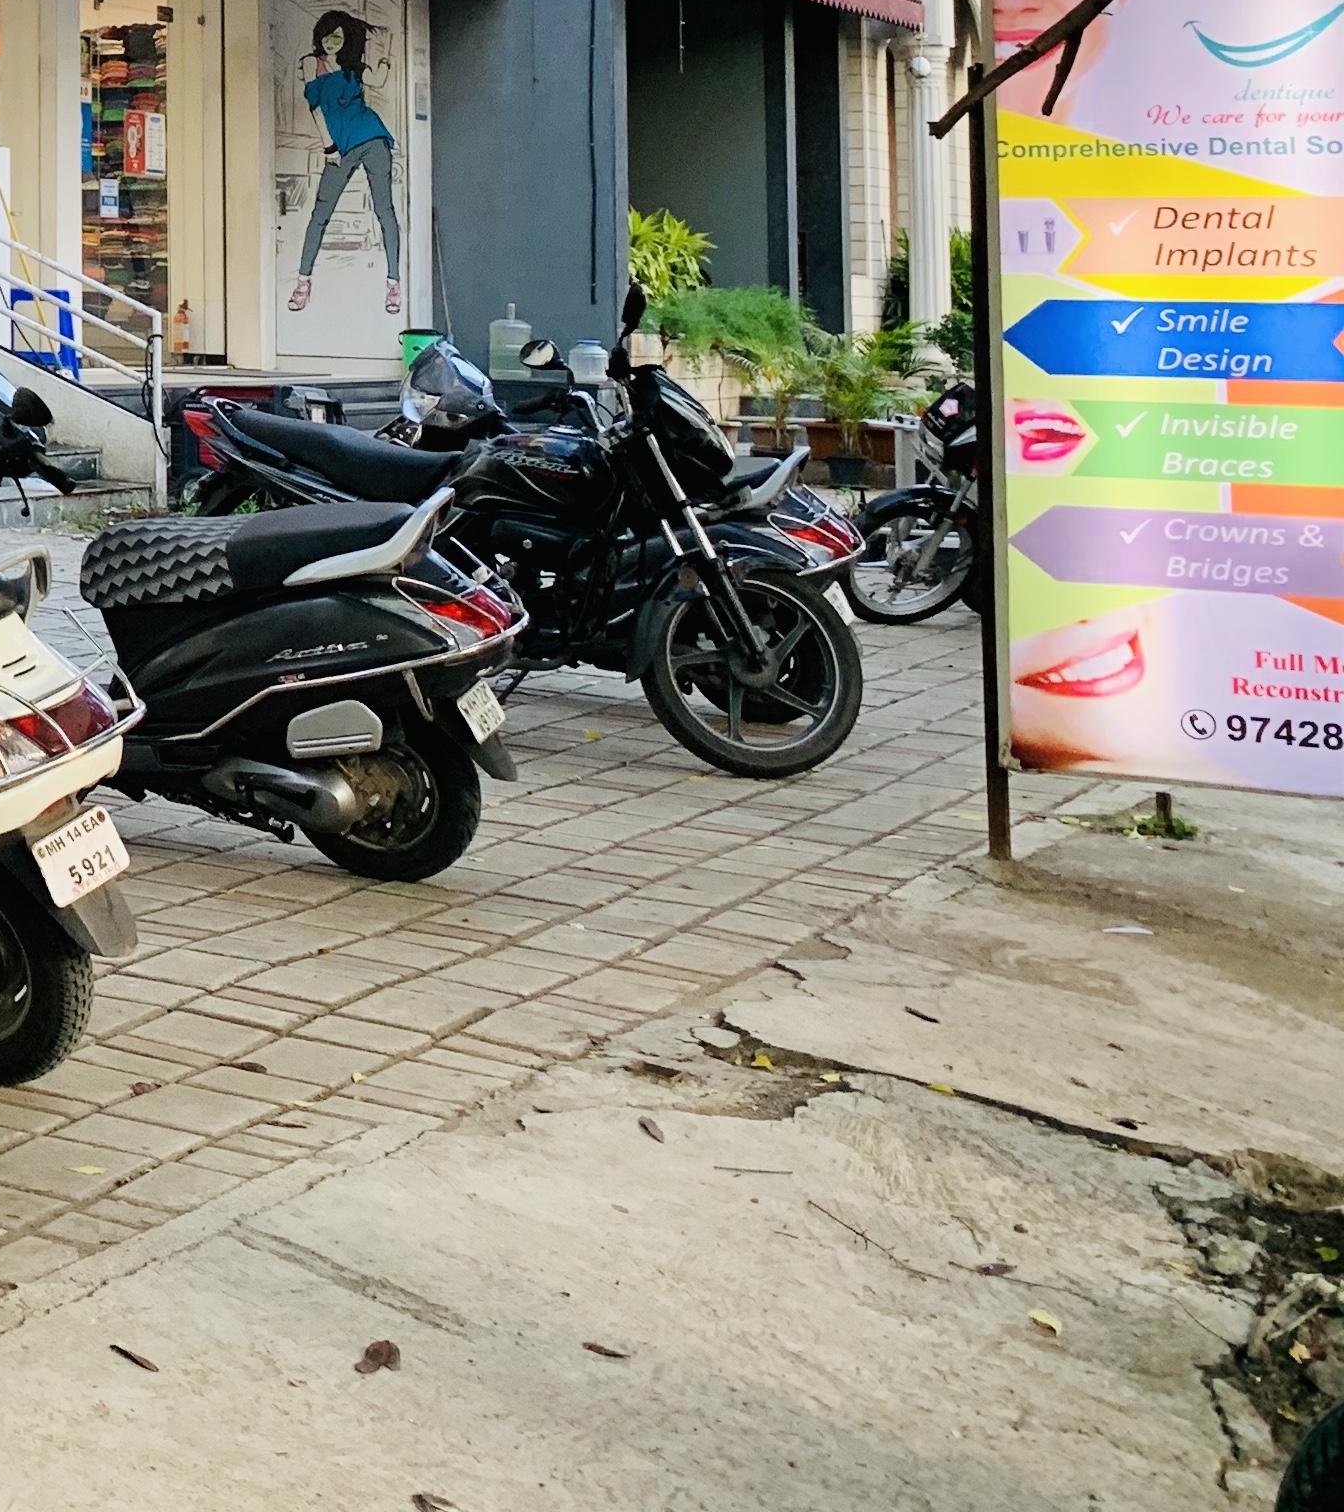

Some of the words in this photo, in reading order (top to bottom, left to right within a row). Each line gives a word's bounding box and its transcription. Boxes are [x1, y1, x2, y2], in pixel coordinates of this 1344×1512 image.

[1233, 79, 1336, 110] dentique
[1146, 104, 1192, 126] We
[1201, 108, 1244, 126] care
[1255, 104, 1287, 128] for
[996, 138, 1199, 162] Comprehensive
[1208, 137, 1296, 156] Dental
[1306, 136, 1344, 155] So
[1154, 205, 1275, 230] Dental
[1155, 242, 1318, 272] Implants
[1156, 308, 1249, 333] Smile
[1157, 347, 1273, 377] Design
[1160, 413, 1299, 440] Invisible
[1162, 451, 1274, 479] Braces
[1164, 518, 1287, 545] Crowns
[1298, 524, 1325, 549] &
[1166, 555, 1290, 587] Bridges
[1254, 651, 1305, 673] Full
[1231, 676, 1344, 703] Reconstr
[1226, 714, 1344, 750] 97428
[44, 836, 66, 856] MH
[66, 826, 82, 842] 14
[81, 816, 100, 833] EA
[68, 844, 116, 885] 5921
